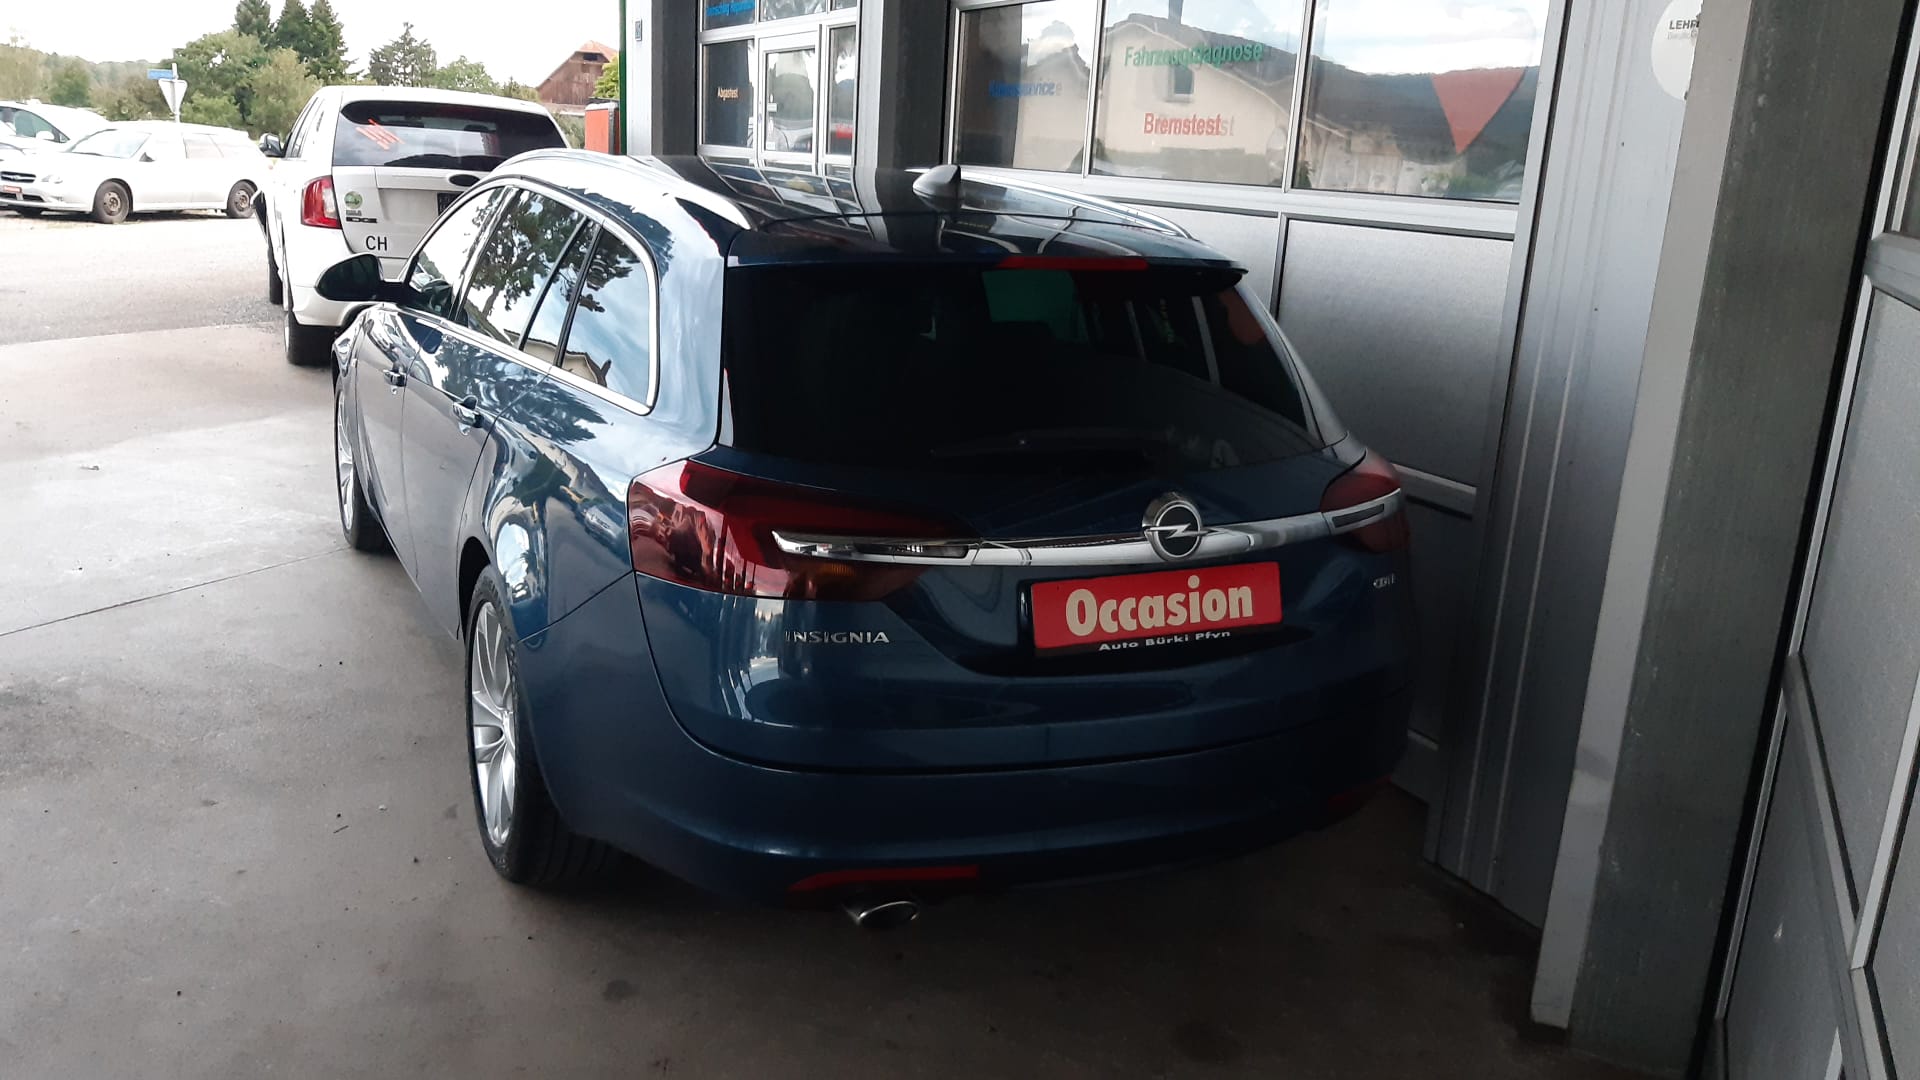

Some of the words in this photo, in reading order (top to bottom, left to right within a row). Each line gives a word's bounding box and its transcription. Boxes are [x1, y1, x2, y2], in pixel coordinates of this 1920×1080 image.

[1124, 42, 1263, 68] Fahrzeugdiagnose
[1143, 112, 1222, 135] Bremstest
[366, 235, 388, 251] CH
[1065, 575, 1253, 637] Occasion
[784, 630, 891, 644] INSIGNIA
[1098, 642, 1140, 652] Auto
[1145, 633, 1189, 647] Bürki
